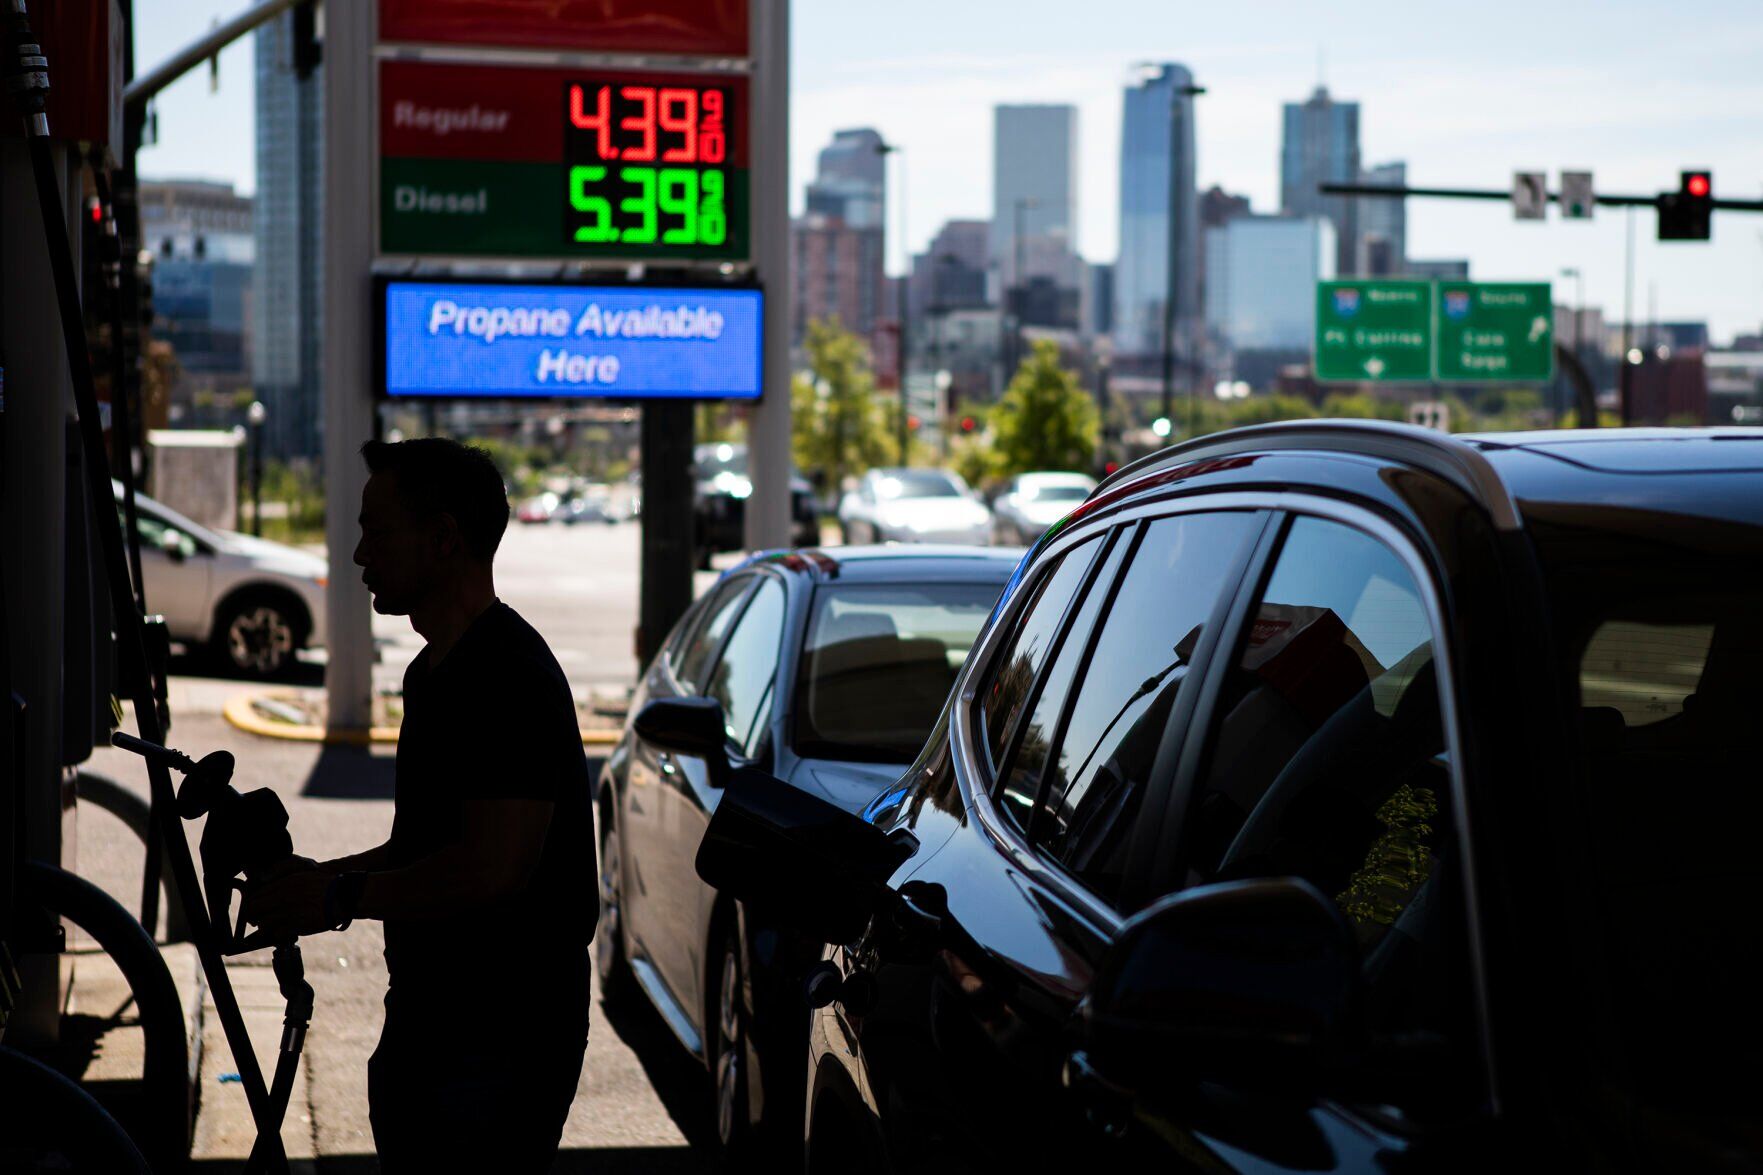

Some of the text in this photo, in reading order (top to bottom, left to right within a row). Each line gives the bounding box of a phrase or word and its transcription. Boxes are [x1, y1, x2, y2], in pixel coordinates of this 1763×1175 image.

[394, 102, 510, 133] Regular
[569, 84, 698, 162] 4.39
[394, 187, 488, 214] Diesel
[569, 165, 698, 244] 5.39
[428, 300, 724, 344] Propane Available
[536, 349, 620, 384] Here
